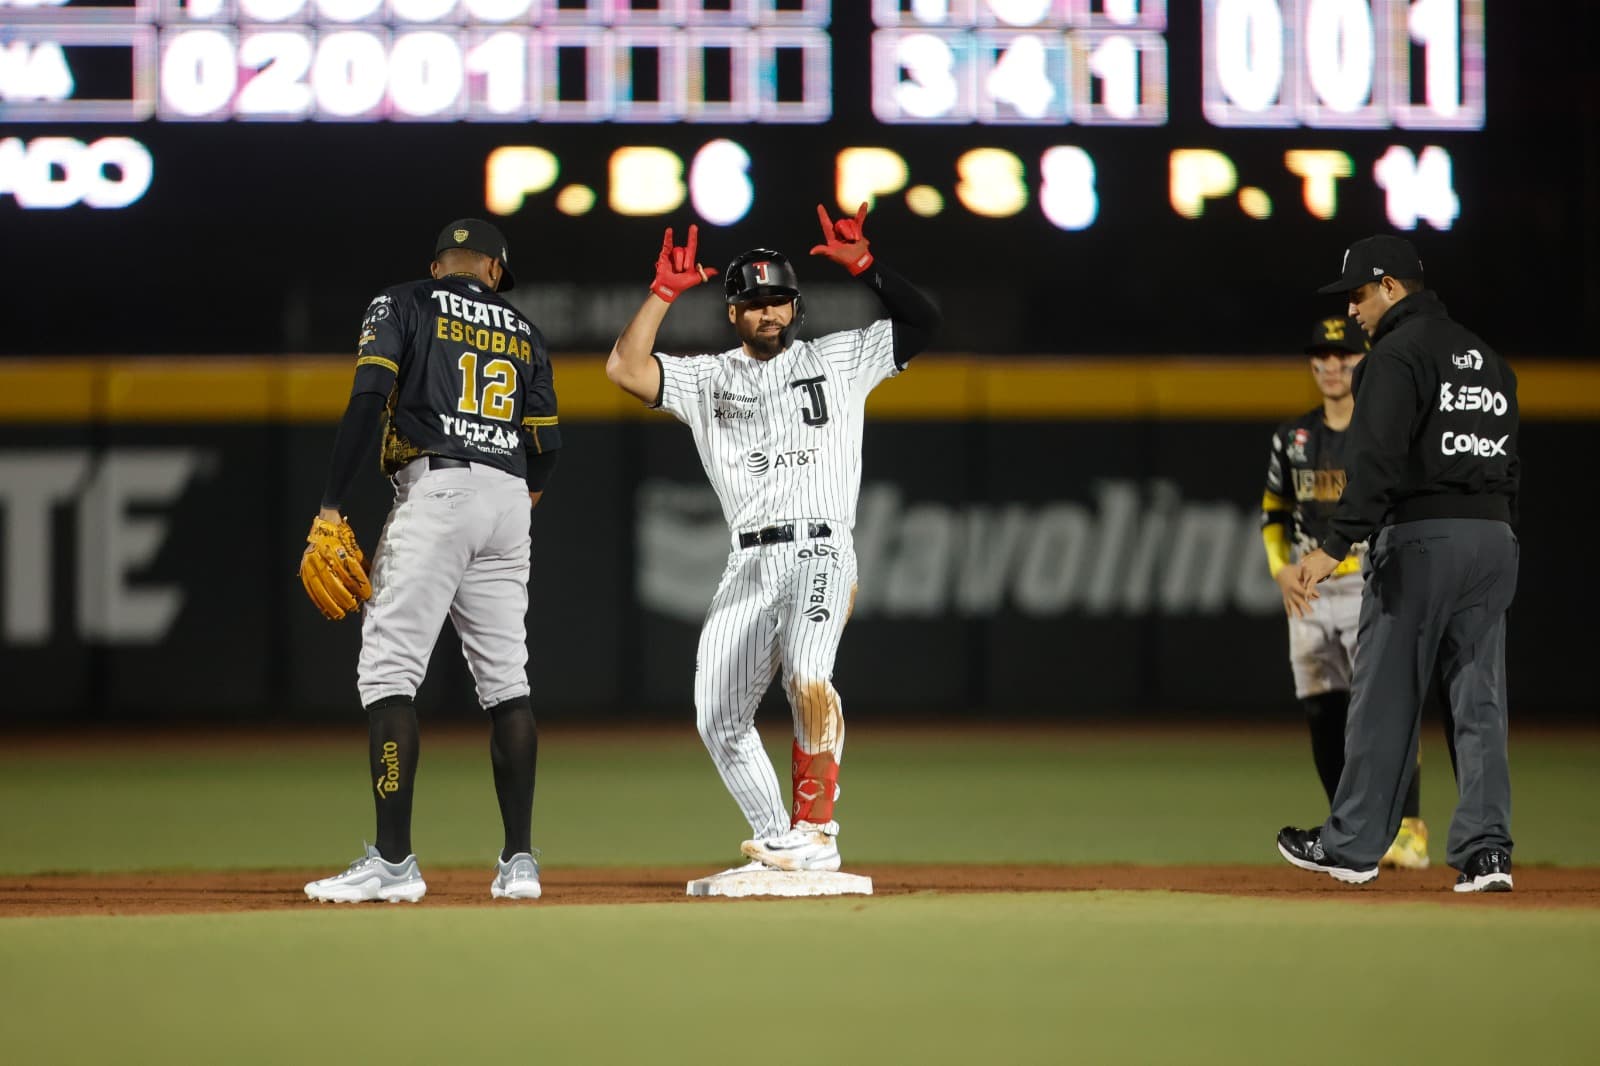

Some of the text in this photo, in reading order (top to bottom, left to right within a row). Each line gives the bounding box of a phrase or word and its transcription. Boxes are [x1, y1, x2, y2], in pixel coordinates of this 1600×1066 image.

[431, 290, 517, 333] TECATE
[436, 315, 532, 365] ESCOBAR
[458, 352, 518, 422] 12
[722, 390, 758, 404] Havoline
[774, 447, 820, 469] AT&T
[810, 572, 828, 604] BAJA
[381, 741, 399, 792] Boxito
